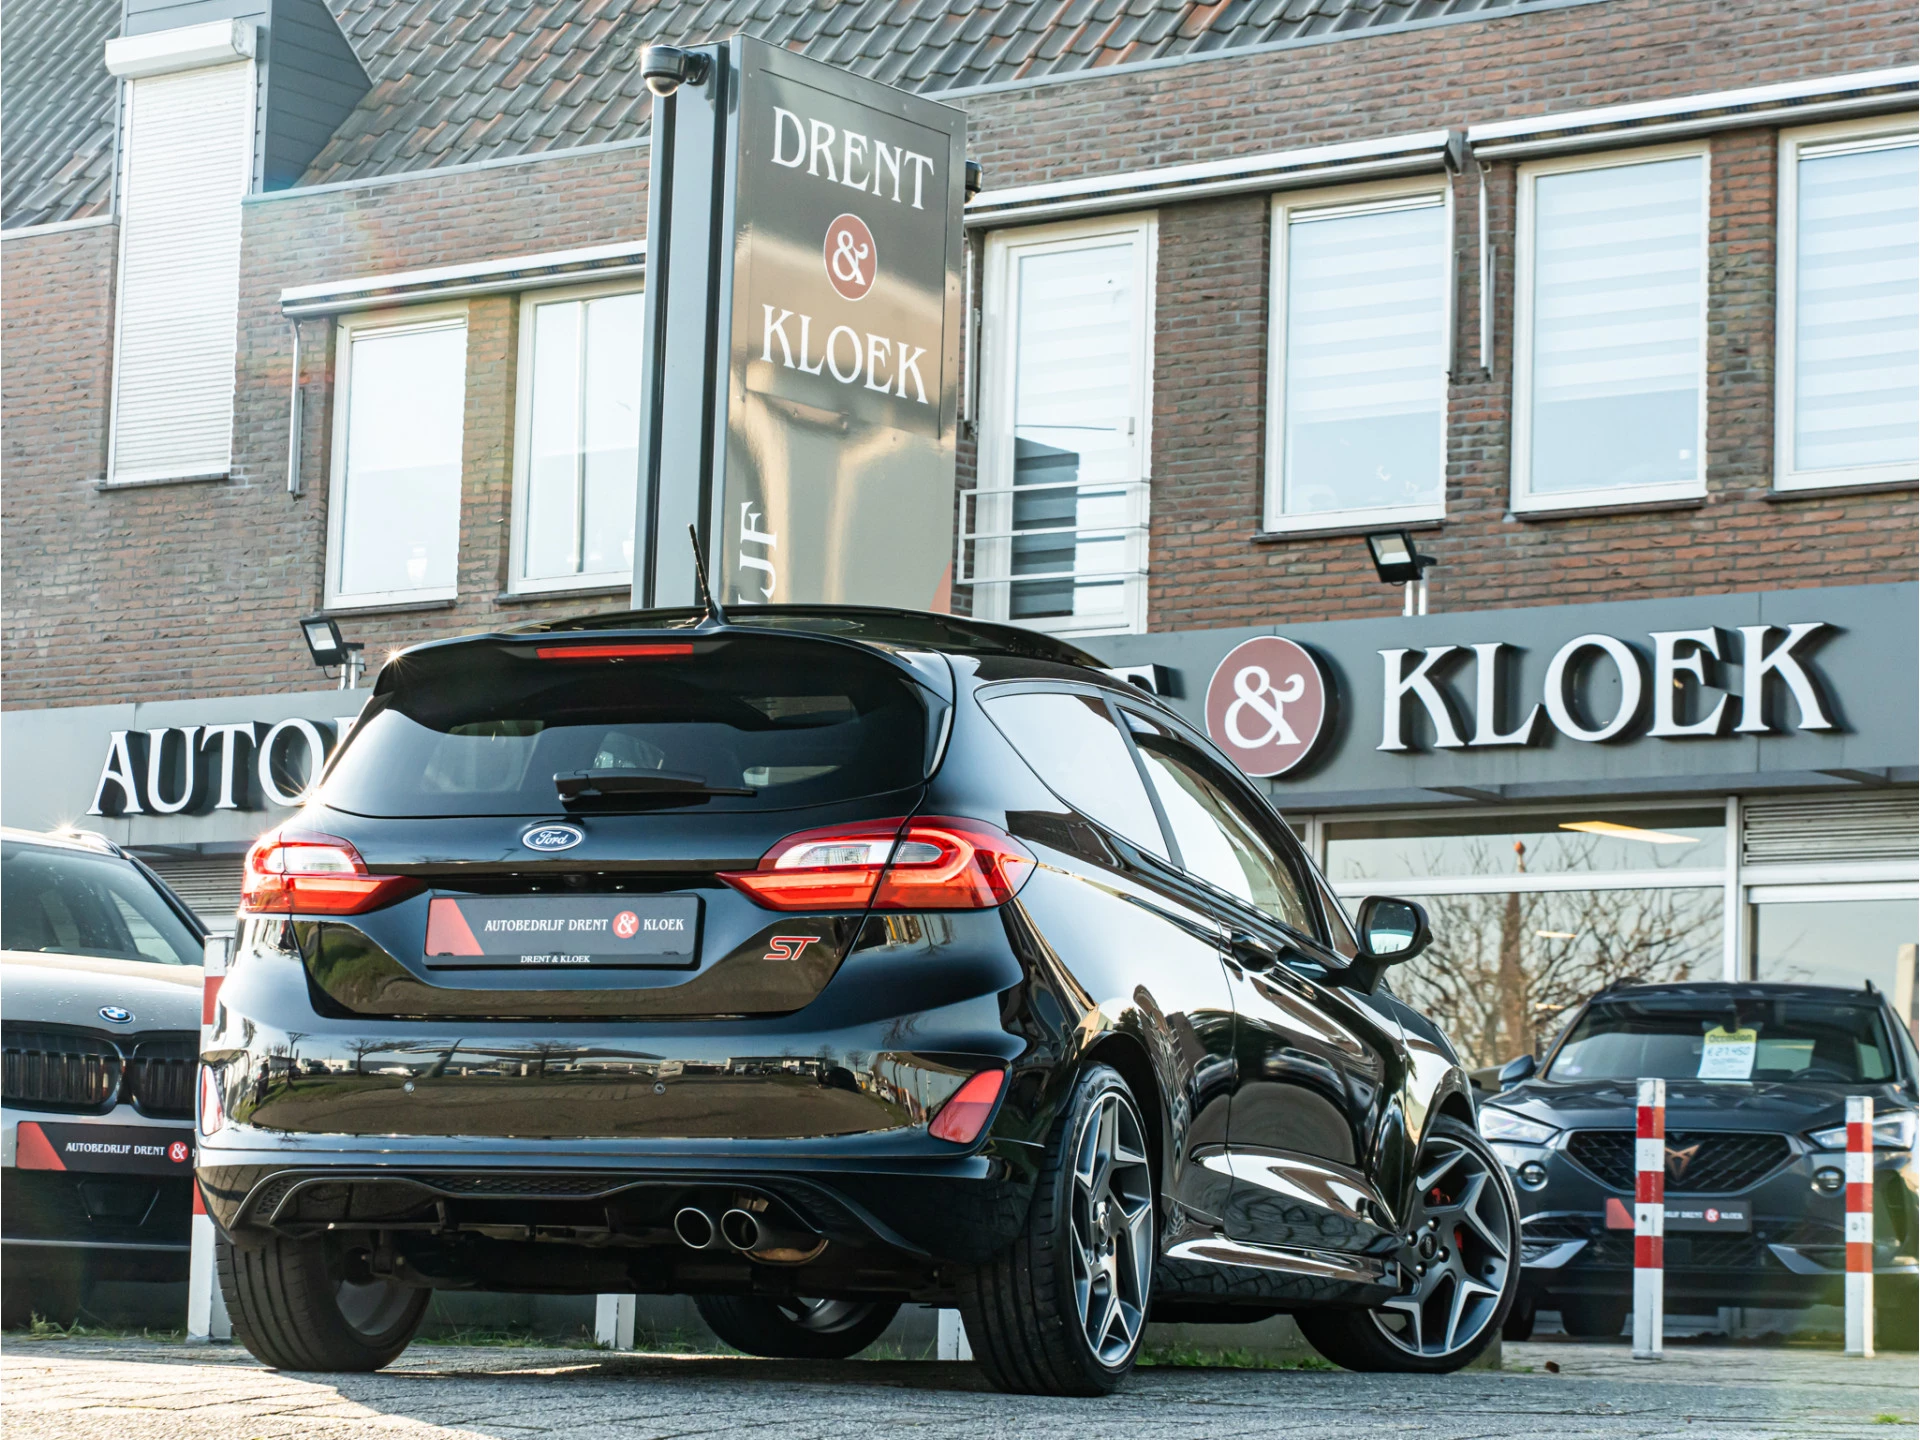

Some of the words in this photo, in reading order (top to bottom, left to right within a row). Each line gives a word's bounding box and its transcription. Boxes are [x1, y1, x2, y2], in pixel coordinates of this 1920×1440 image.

[771, 106, 934, 210] DRENT
[832, 230, 868, 285] &
[760, 304, 928, 404] KLOEK
[1224, 665, 1305, 749] &
[1376, 622, 1833, 751] KLOEK
[535, 830, 569, 845] Ford
[484, 919, 564, 932] AUTOBEDRIJF
[568, 919, 608, 931] DRENT
[617, 913, 636, 935] &
[643, 918, 684, 931] KLOEK
[520, 955, 550, 963] DRENT
[551, 955, 558, 963] &
[560, 955, 590, 963] KLOEK
[763, 936, 821, 960] ST
[66, 1142, 131, 1154] AUTOBEDRIJF
[134, 1145, 165, 1156] DRENT
[172, 1143, 186, 1159] &
